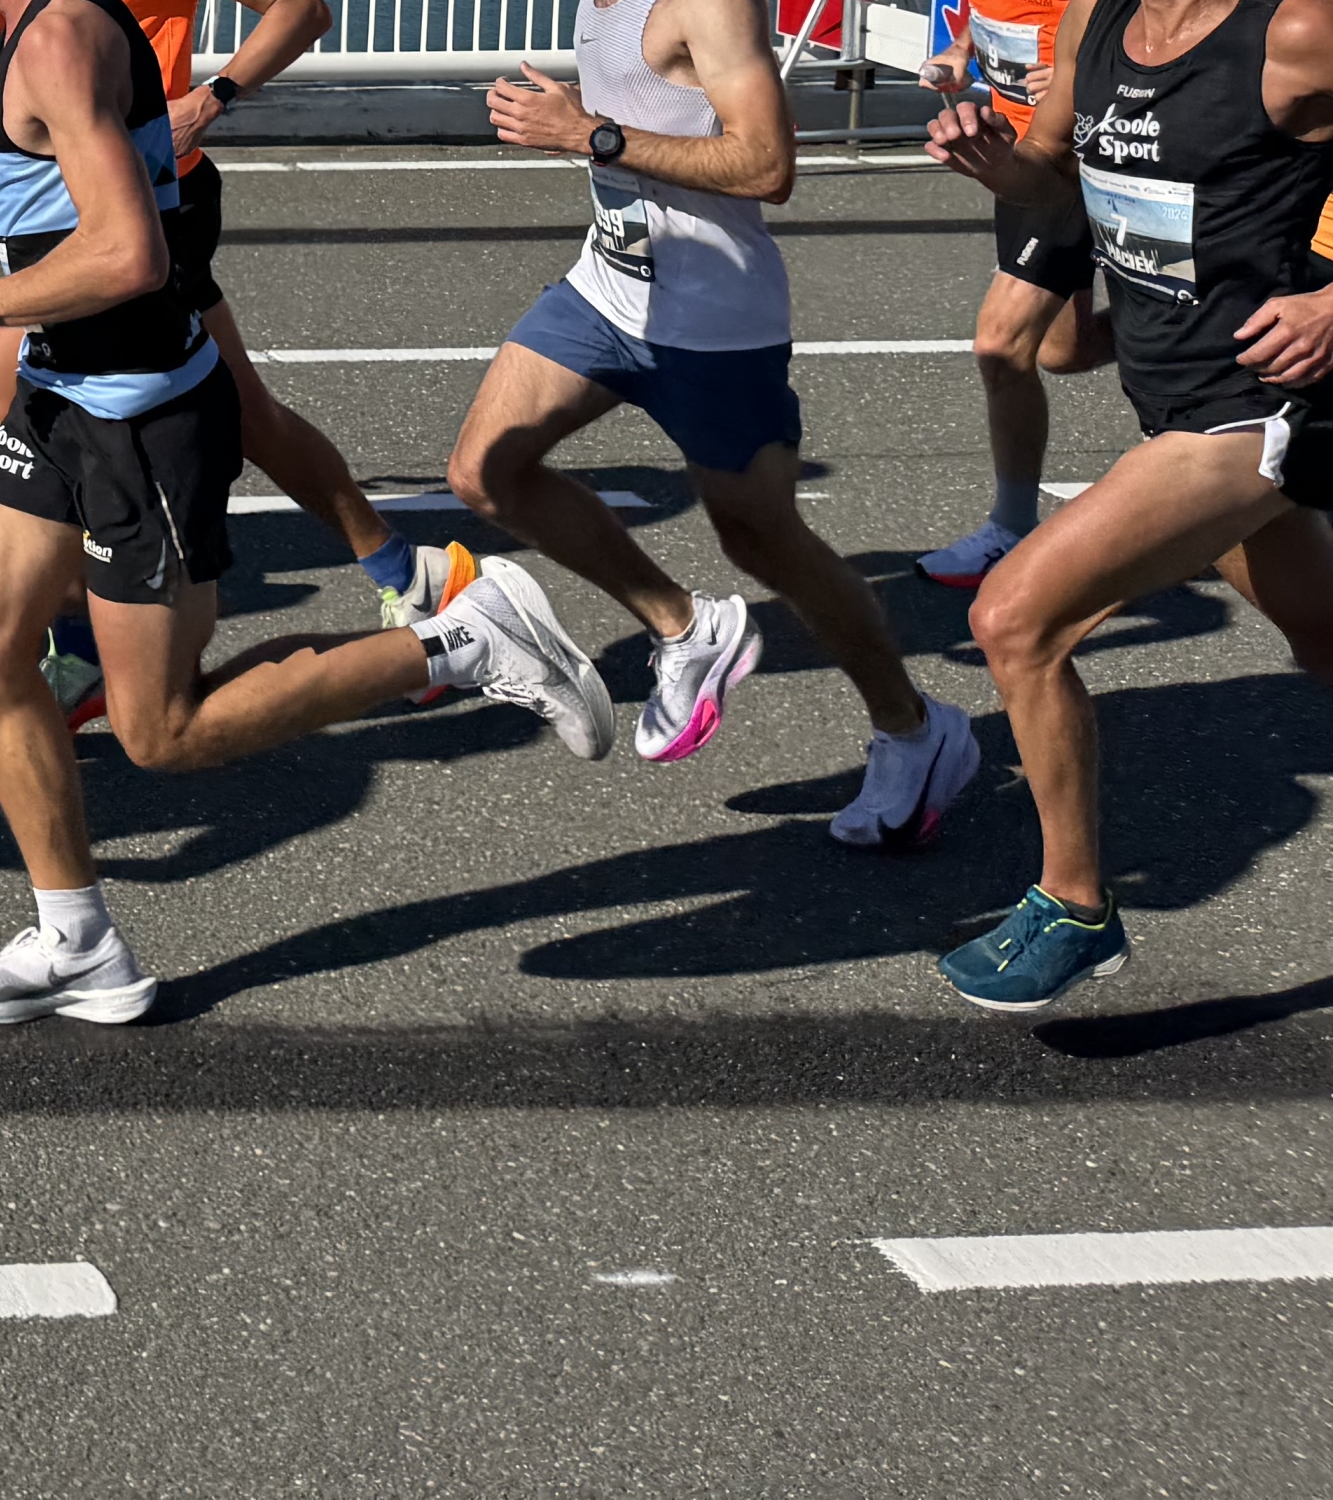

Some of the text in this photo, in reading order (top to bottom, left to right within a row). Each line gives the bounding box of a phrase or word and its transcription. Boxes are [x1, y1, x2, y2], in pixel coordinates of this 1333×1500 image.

[988, 44, 1000, 69] 9
[1098, 135, 1161, 165] Sport
[1110, 211, 1128, 247] 7
